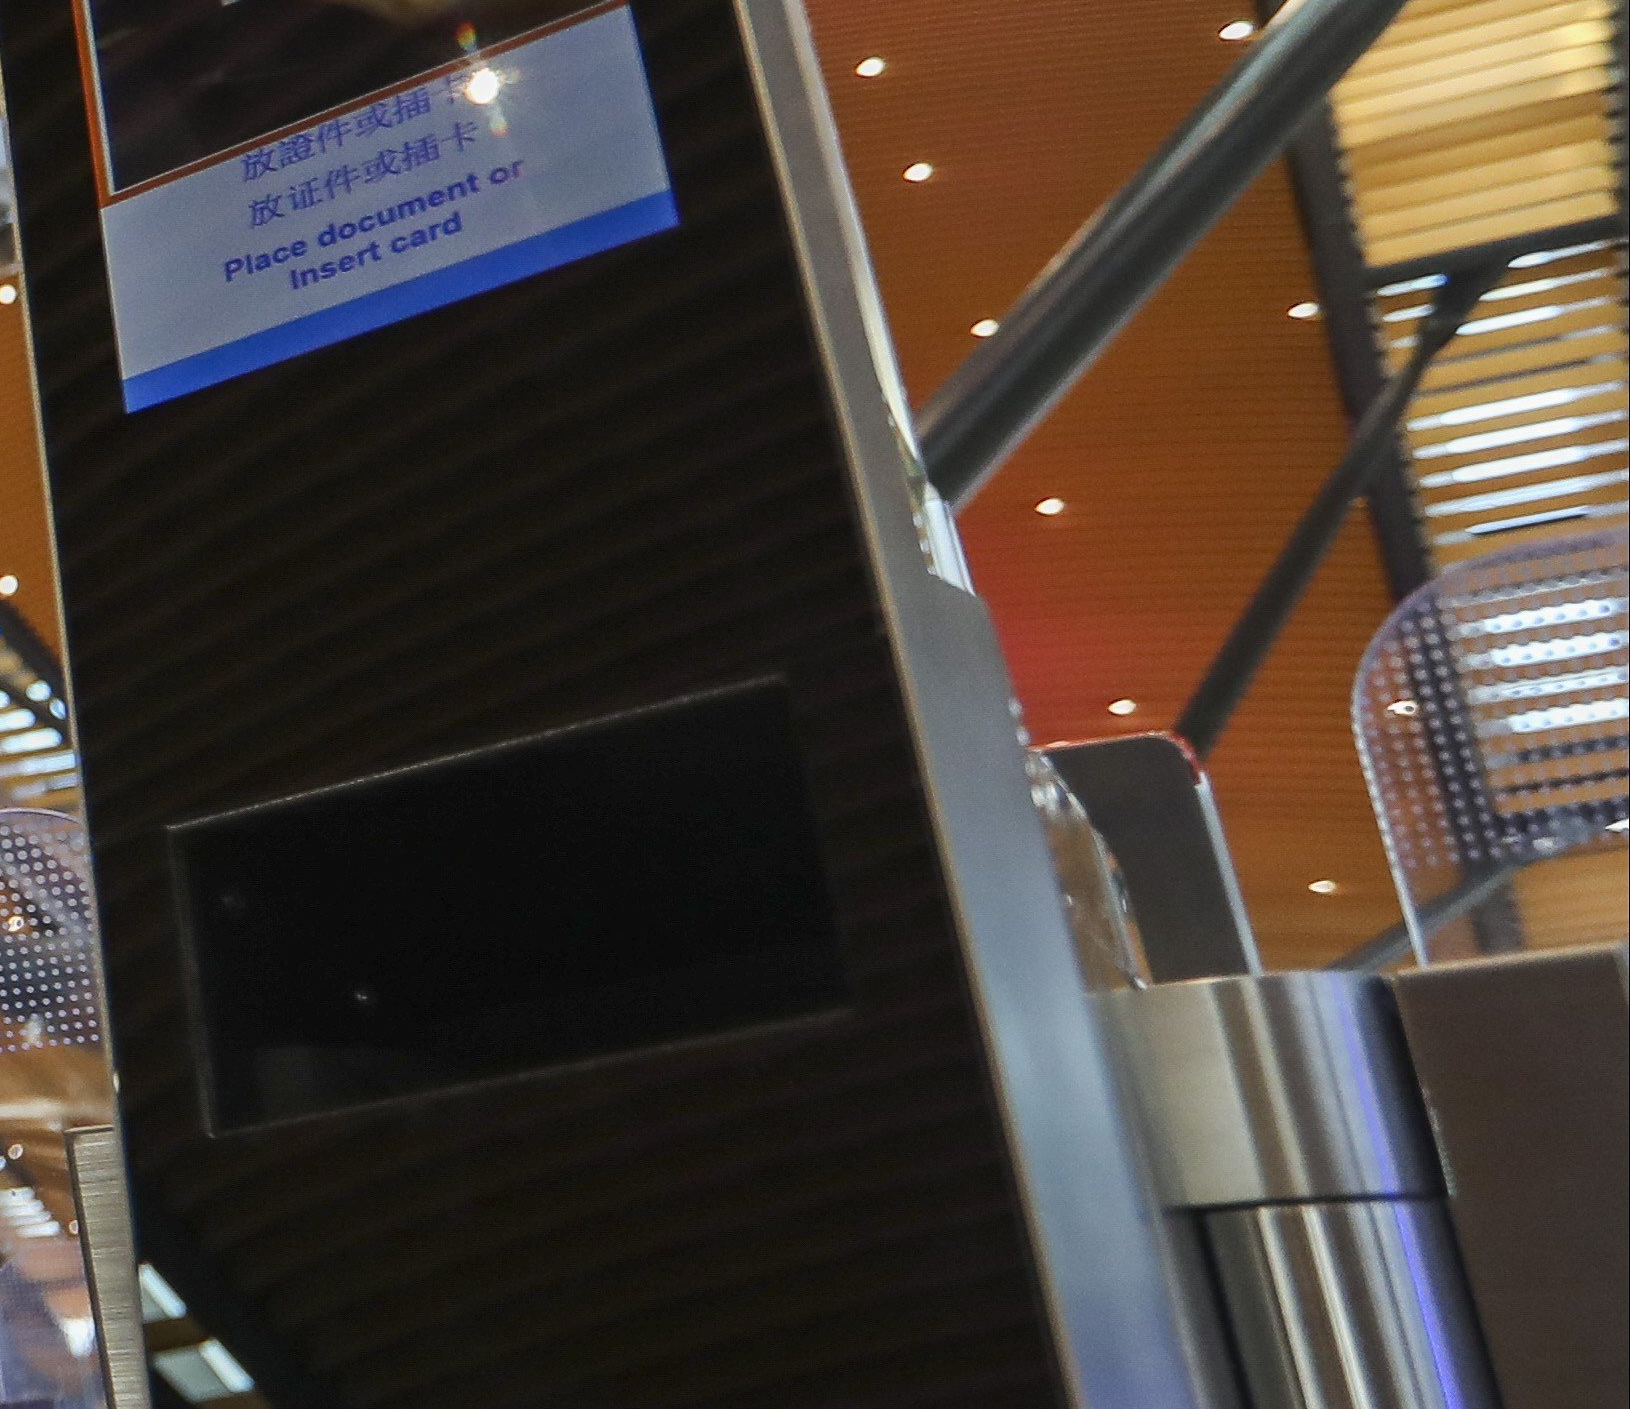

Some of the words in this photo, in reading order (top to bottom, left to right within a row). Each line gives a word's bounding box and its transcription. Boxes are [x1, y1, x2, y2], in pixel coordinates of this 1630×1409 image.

[224, 238, 308, 283] Place
[317, 173, 482, 249] document
[489, 160, 525, 188] or
[288, 241, 384, 290] Insert
[389, 211, 463, 255] card
